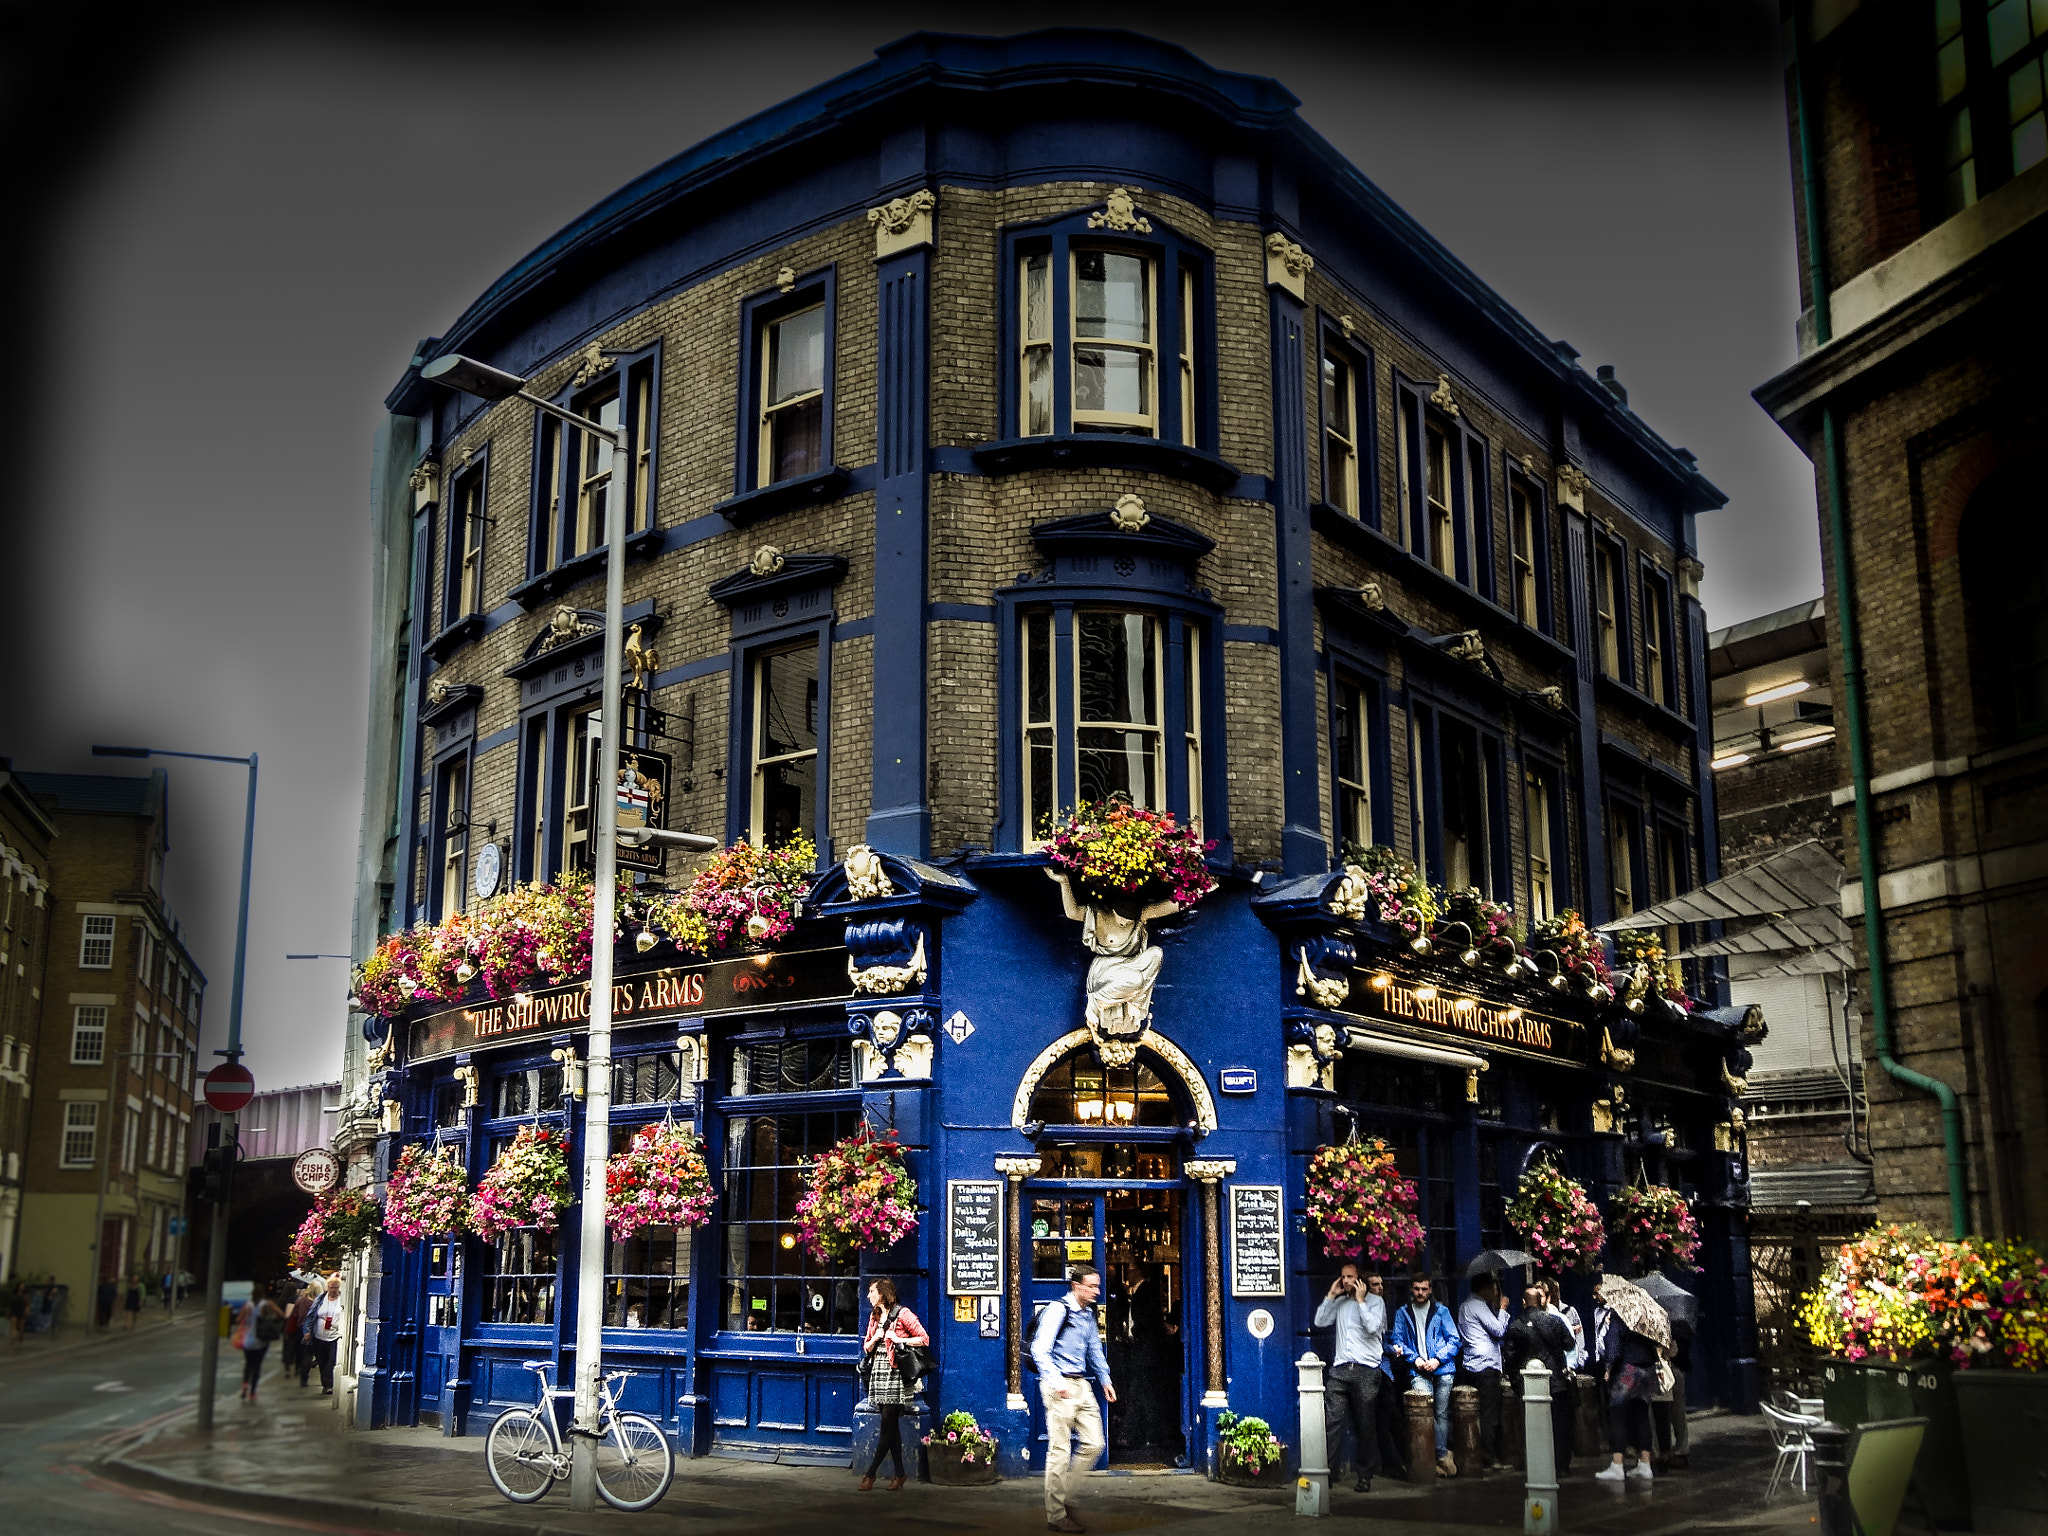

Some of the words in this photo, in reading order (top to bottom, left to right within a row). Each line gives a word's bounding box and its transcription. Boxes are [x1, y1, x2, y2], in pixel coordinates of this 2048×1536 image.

[474, 1006, 503, 1036] THE
[506, 984, 634, 1032] SHIPWRIGTS
[639, 973, 704, 1012] ARMS
[1383, 986, 1414, 1017] THE
[1417, 994, 1515, 1041] SHIPWRIGHTS
[1517, 1016, 1552, 1048] ARMS
[951, 1019, 967, 1036] H
[301, 1163, 323, 1172] FISH
[325, 1163, 331, 1172] &
[301, 1172, 330, 1182] CHIPS
[954, 1227, 977, 1240] Daily
[1825, 1366, 1835, 1382] 40
[1917, 1374, 1937, 1390] 40
